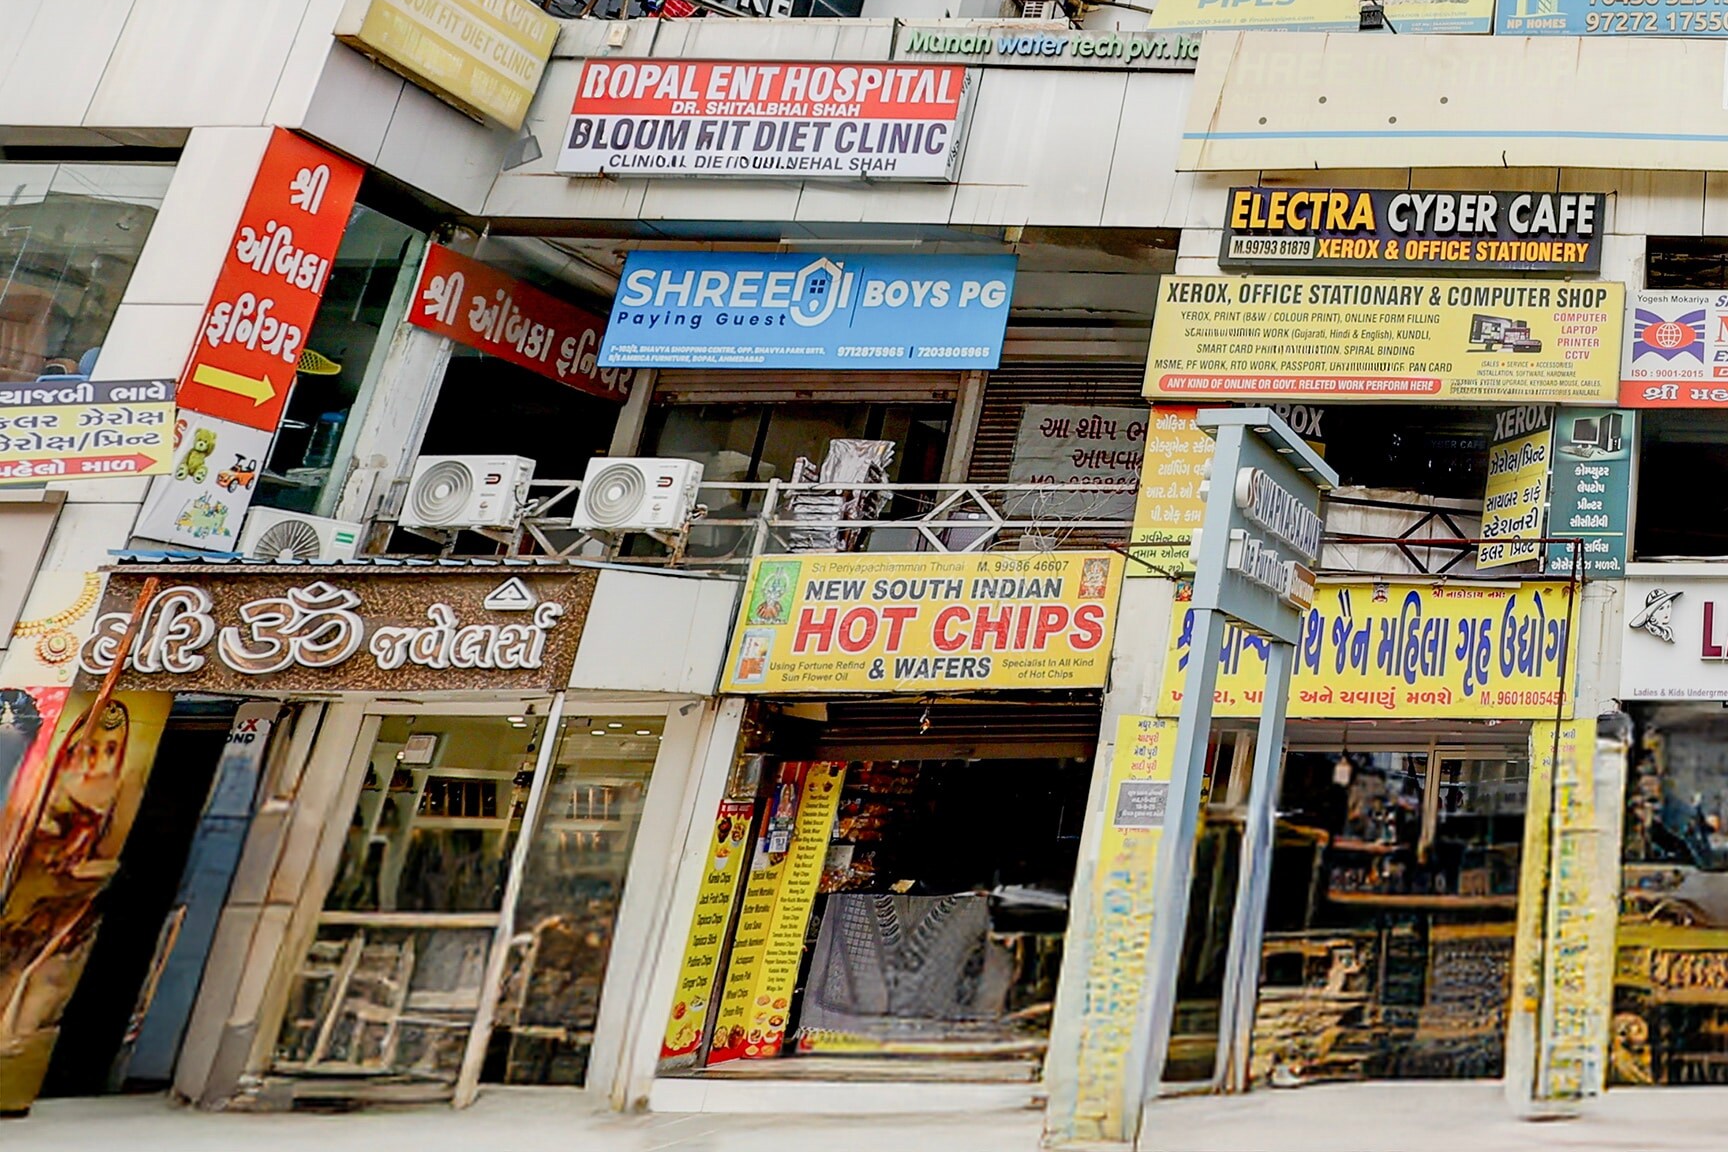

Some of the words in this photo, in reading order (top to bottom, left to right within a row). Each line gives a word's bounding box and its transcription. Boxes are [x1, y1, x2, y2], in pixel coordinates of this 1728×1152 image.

[1507, 18, 1522, 28] NP
[1526, 18, 1566, 28] HOMES
[1585, 12, 1658, 32] 97272
[437, 4, 460, 33] FIT
[461, 24, 495, 55] DIET
[492, 39, 536, 81] CLINIC
[997, 33, 1068, 56] water
[1071, 34, 1123, 57] tech
[582, 64, 701, 99] BOPAL
[706, 65, 780, 101] ENT
[781, 67, 955, 103] HOSPITAL
[671, 101, 700, 114] DR.
[705, 102, 808, 116] SHITALBHAI
[812, 103, 860, 117] SHAH
[568, 118, 691, 151] BLOOM
[753, 121, 831, 152] DIET
[834, 122, 947, 154] CLINIC
[849, 157, 897, 171] SHAH
[290, 164, 330, 215] શ્રી
[1231, 191, 1376, 231] ELECTRA
[1388, 193, 1497, 233] CYBER
[1508, 194, 1595, 235] CAFE
[236, 220, 328, 295] અંબિકા
[1317, 238, 1380, 259] XEROX
[1384, 239, 1399, 260] &
[1405, 239, 1471, 261] OFFICE
[1475, 241, 1589, 263] STATIONERY
[423, 271, 465, 326] શ્રી
[863, 280, 950, 308] BOYS
[958, 280, 1007, 308] PG
[1167, 283, 1232, 306] XEROX,
[1239, 283, 1303, 304] OFFICE
[1308, 284, 1424, 306] STATIONARY
[1428, 286, 1441, 306] &
[1448, 286, 1550, 308] COMPUTER
[1556, 288, 1607, 309] SHOP
[1637, 295, 1668, 303] Yogesh
[617, 311, 702, 328] Paying
[716, 312, 786, 326] Guest
[1345, 313, 1378, 323] ONLINE
[1380, 314, 1405, 323] FORM
[1406, 314, 1440, 324] FILLING
[1553, 312, 1607, 323] COMPUTER
[1561, 325, 1598, 335] LAPTOP
[1197, 343, 1227, 353] SMART
[1229, 344, 1253, 354] CARD
[1377, 346, 1415, 356] BINDING
[1557, 338, 1600, 348] PRINTER
[1565, 350, 1590, 360] CCTV
[1409, 362, 1426, 372] PAN
[1428, 362, 1452, 373] CARD
[110, 381, 166, 402] ભાવે
[1167, 378, 1185, 389] ANY
[1187, 378, 1210, 389] KIND
[1211, 379, 1223, 389] OF
[1225, 379, 1257, 389] ONLINE
[995, 561, 1030, 572] 99986
[1033, 560, 1069, 571] 46607
[804, 579, 866, 601] NEW
[872, 579, 963, 600] SOUTH
[971, 578, 1062, 599] INDIAN
[793, 606, 918, 653] HOT
[933, 605, 1104, 652] CHIPS
[1377, 590, 1449, 685] મહિલા
[1455, 617, 1493, 697] ગૃહ
[769, 661, 796, 672] Using
[799, 661, 833, 670] Fortune
[868, 658, 884, 680] &
[894, 657, 992, 679] WAFERS
[1002, 658, 1046, 669] Specialist
[1048, 659, 1057, 667] In
[1059, 658, 1071, 667] All
[1073, 658, 1094, 667] Kind
[781, 674, 799, 682] Sun
[802, 673, 833, 681] Flower
[835, 672, 848, 681] Oil
[1030, 670, 1045, 679] Hot
[1048, 669, 1074, 680] Chips
[1300, 686, 1333, 704] અને
[1406, 687, 1452, 705] મળશે
[1633, 688, 1659, 697] Ladies
[1668, 688, 1684, 697] Kids
